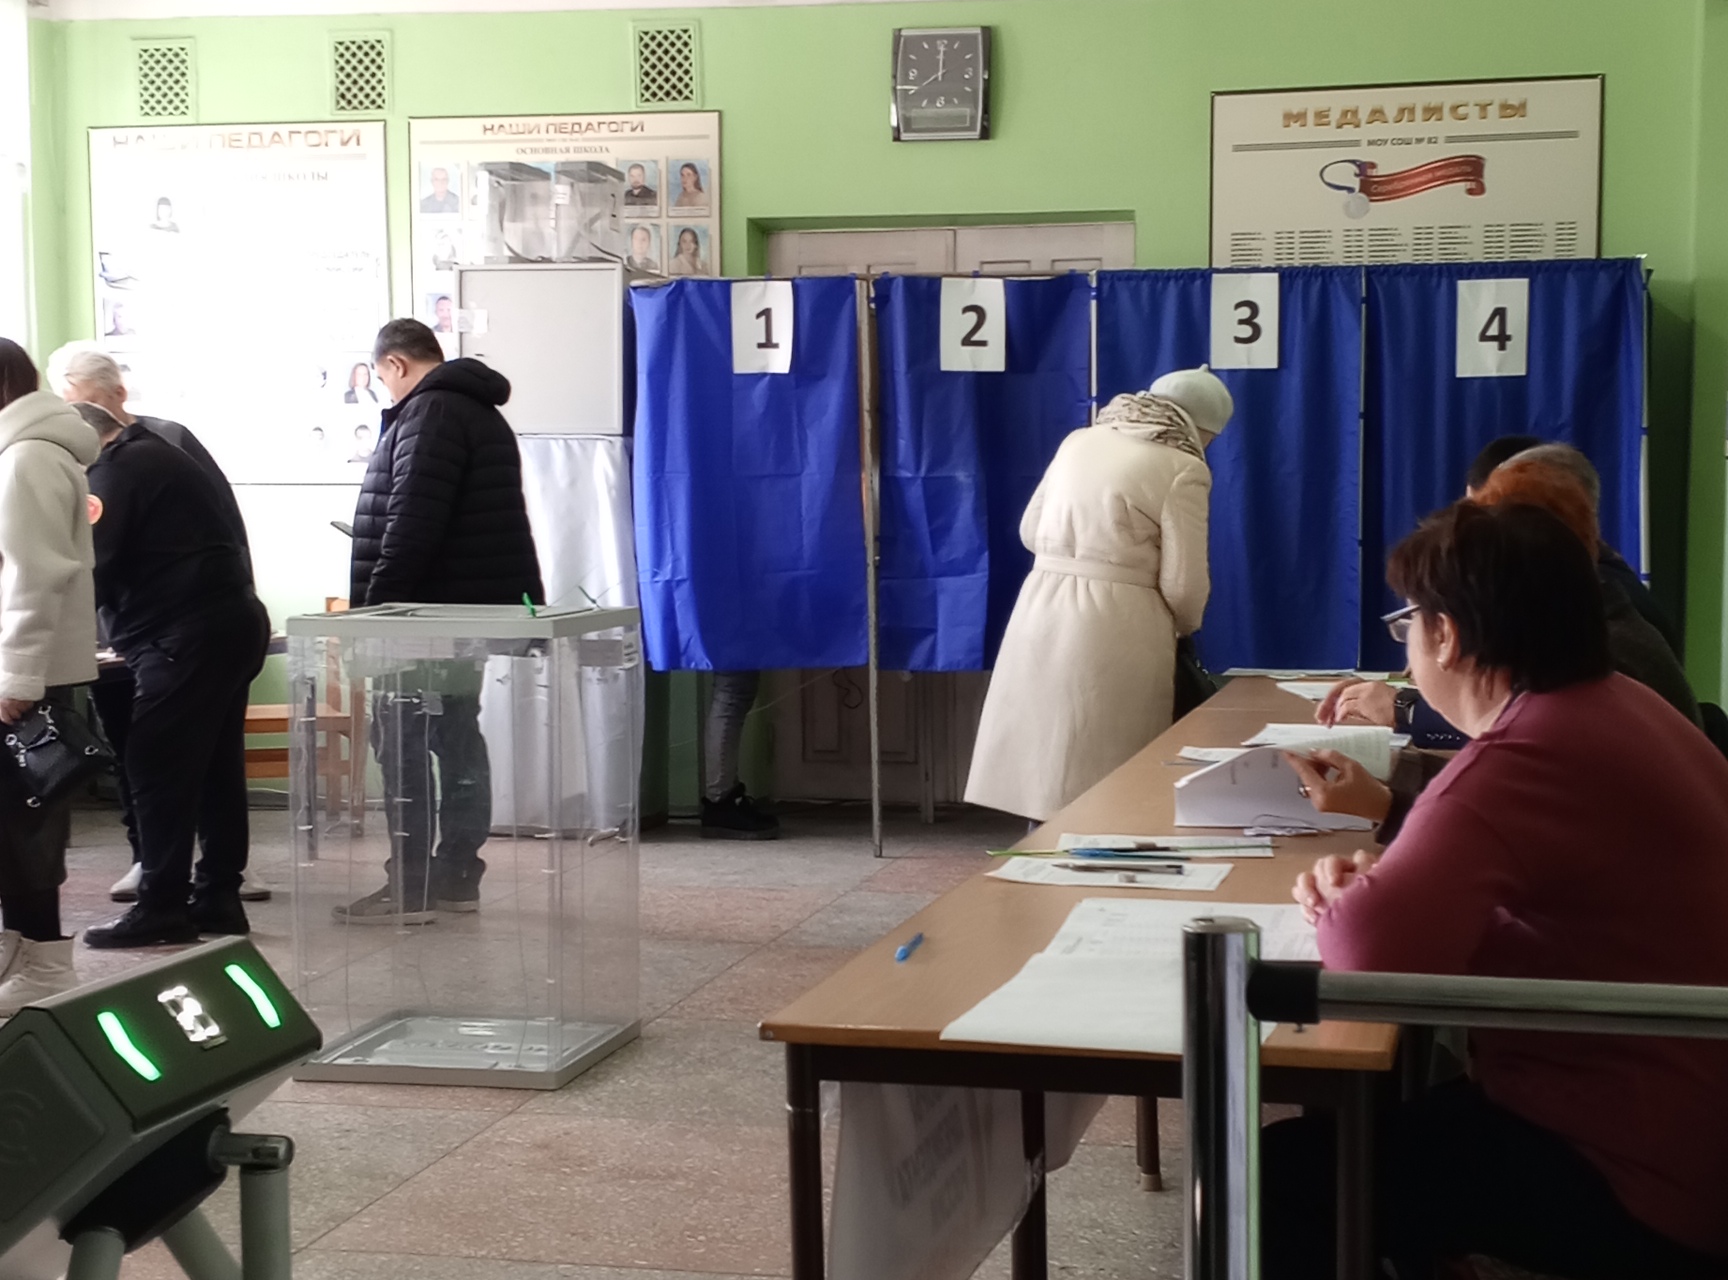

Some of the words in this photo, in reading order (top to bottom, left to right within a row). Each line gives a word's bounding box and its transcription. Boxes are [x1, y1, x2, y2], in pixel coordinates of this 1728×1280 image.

[483, 123, 540, 135] НАШИ
[546, 121, 645, 135] ПЕДАГОГИ
[1281, 97, 1529, 129] МЕДАЛИСТЫ
[209, 128, 362, 150] ПЕДАГОГИ
[516, 147, 571, 156] ОСНОВНАЯ
[573, 146, 610, 154] ШКОЛА
[1367, 138, 1389, 147] МОУ
[1391, 136, 1413, 146] СОШ
[755, 307, 779, 349] 1
[961, 304, 989, 347] 2
[1233, 299, 1263, 345] 3
[1478, 306, 1513, 352] 4
